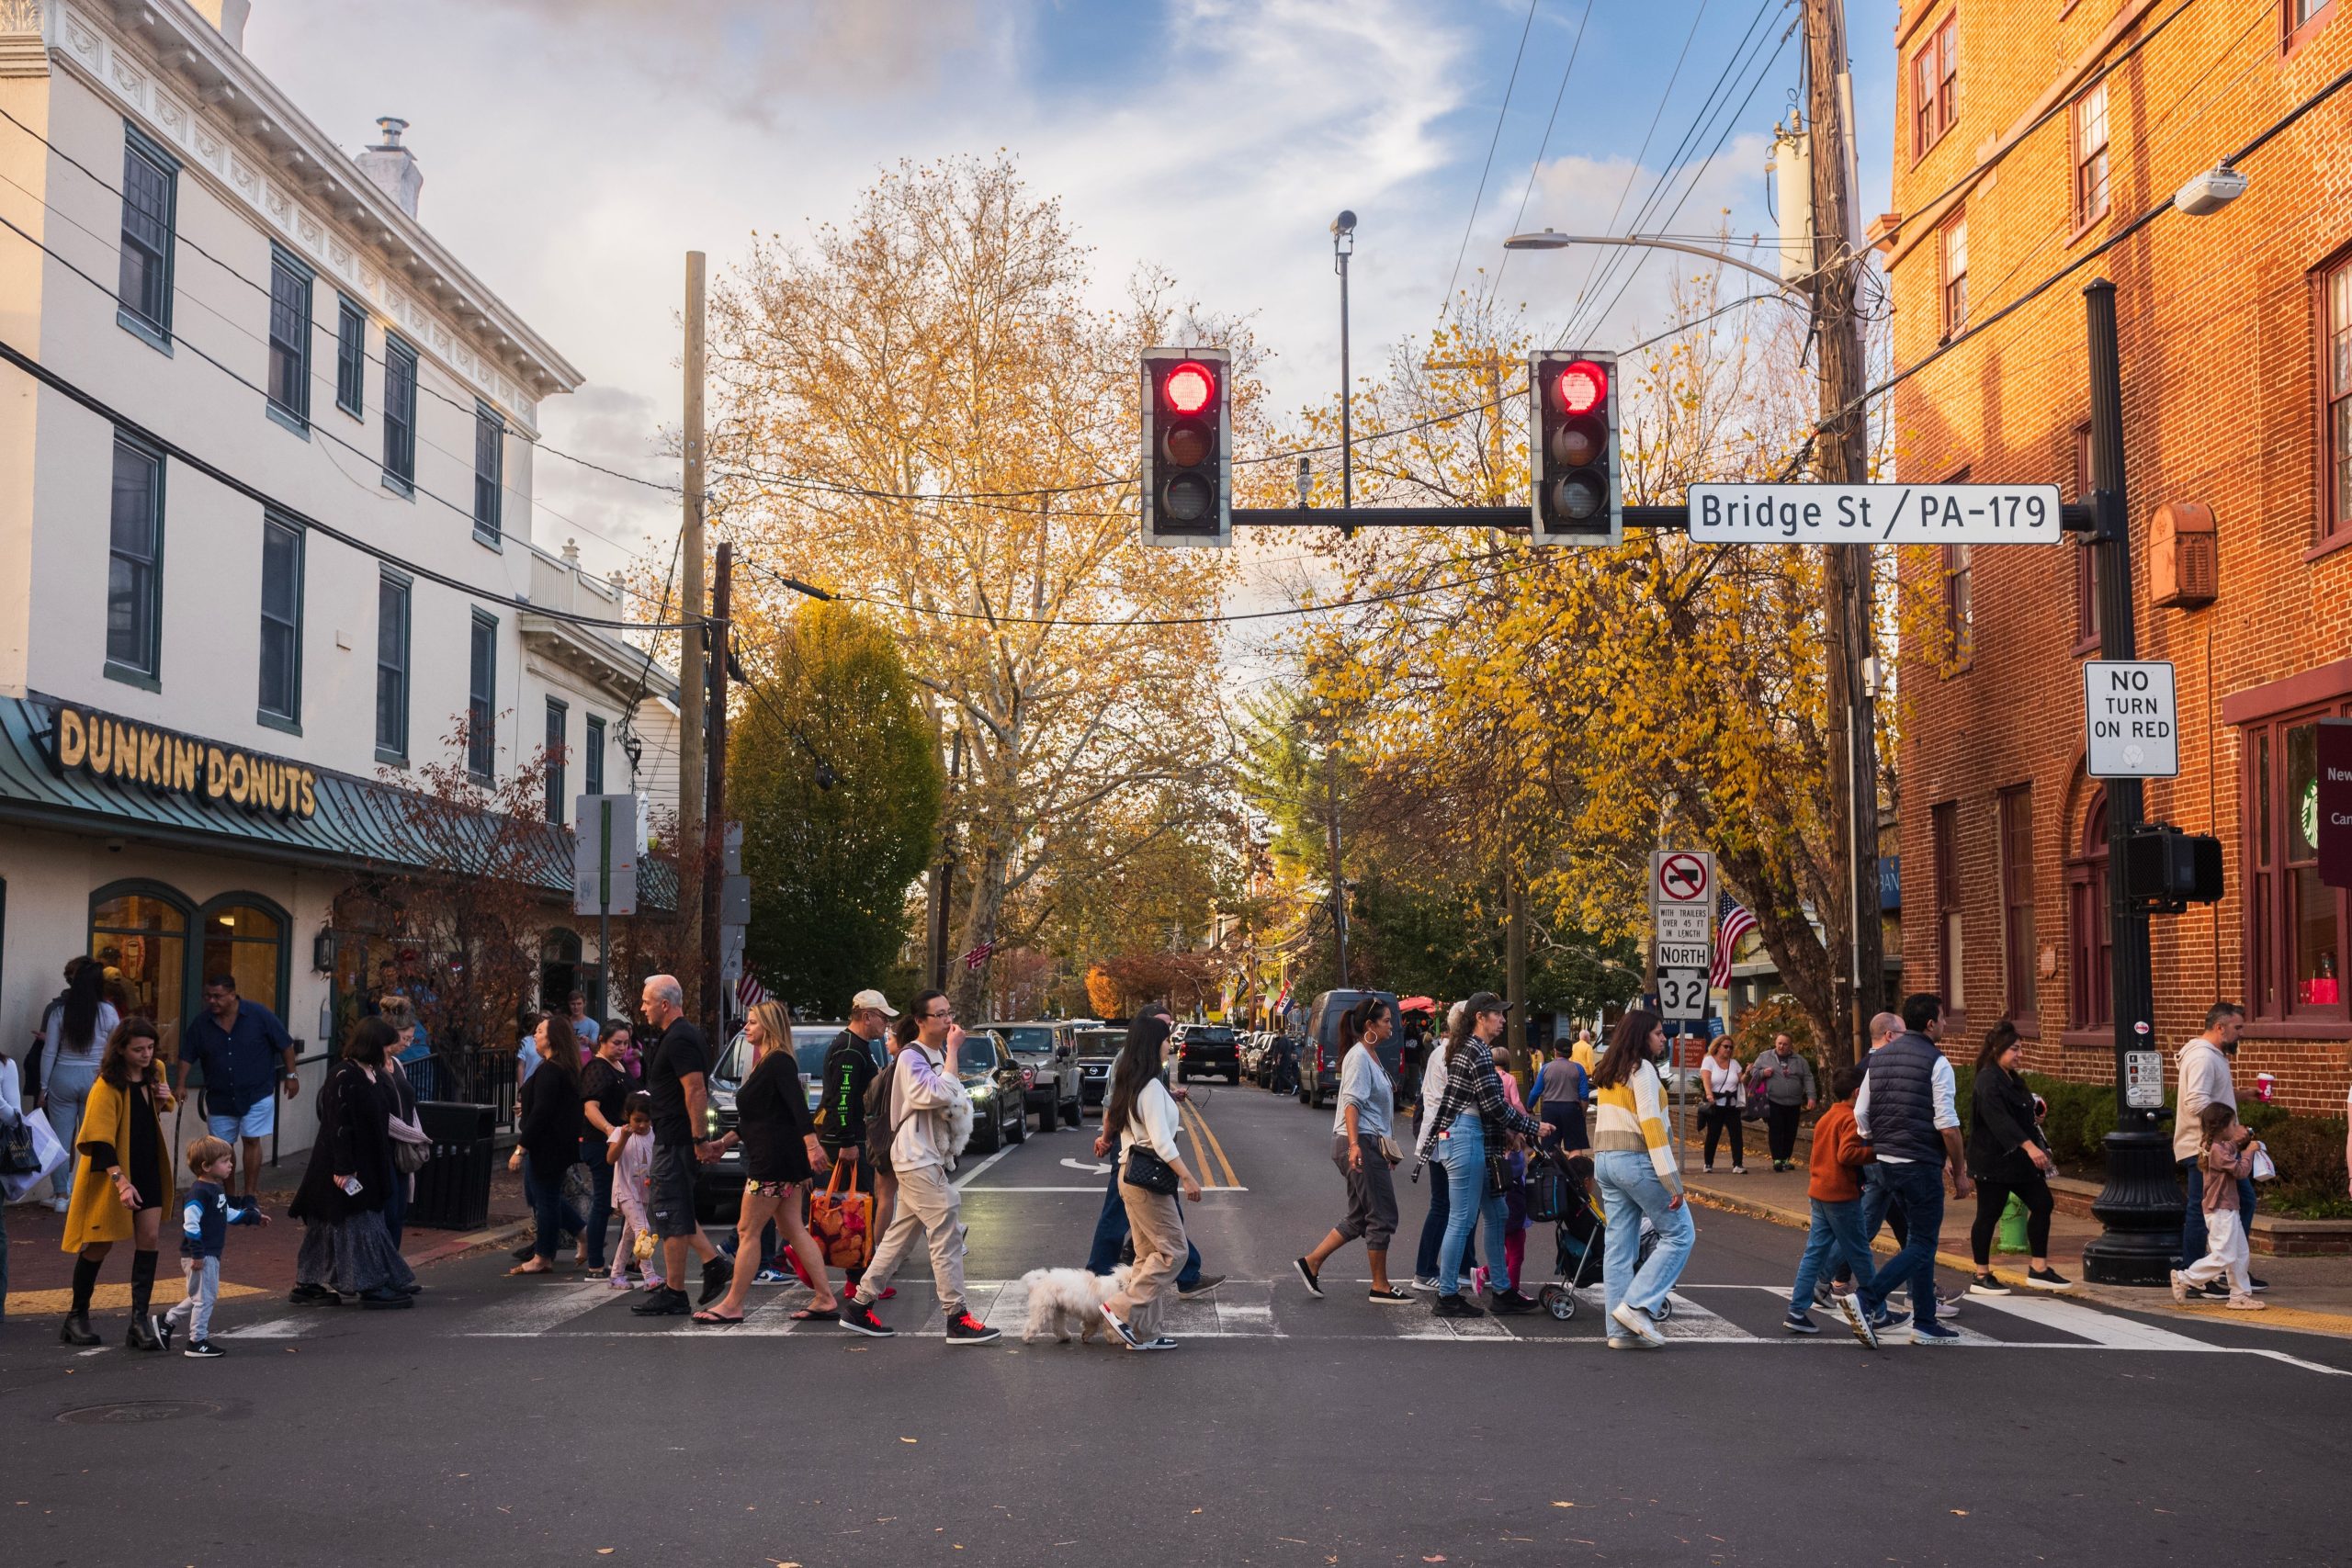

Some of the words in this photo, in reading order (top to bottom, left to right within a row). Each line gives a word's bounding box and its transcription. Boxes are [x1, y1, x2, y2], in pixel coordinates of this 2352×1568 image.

[1702, 494, 1821, 536] Bridge
[1838, 495, 1871, 528] St
[1920, 495, 2046, 528] PA-179
[2111, 671, 2149, 692] NO
[2105, 697, 2157, 715] TURN
[2095, 720, 2120, 738] ON
[2132, 721, 2170, 738] RED
[60, 708, 204, 793] DUNKIN'
[207, 747, 317, 818] DONUTS
[1660, 908, 1674, 917] WITH
[1679, 908, 1707, 918] TRAILERS
[1662, 919, 1678, 928] OVER
[1683, 919, 1691, 928] 45
[1697, 919, 1704, 928] FT
[1666, 929, 1672, 937] IN
[1678, 929, 1701, 938] LENGTH
[1660, 946, 1706, 964] NORTH
[1664, 980, 1702, 1010] 32
